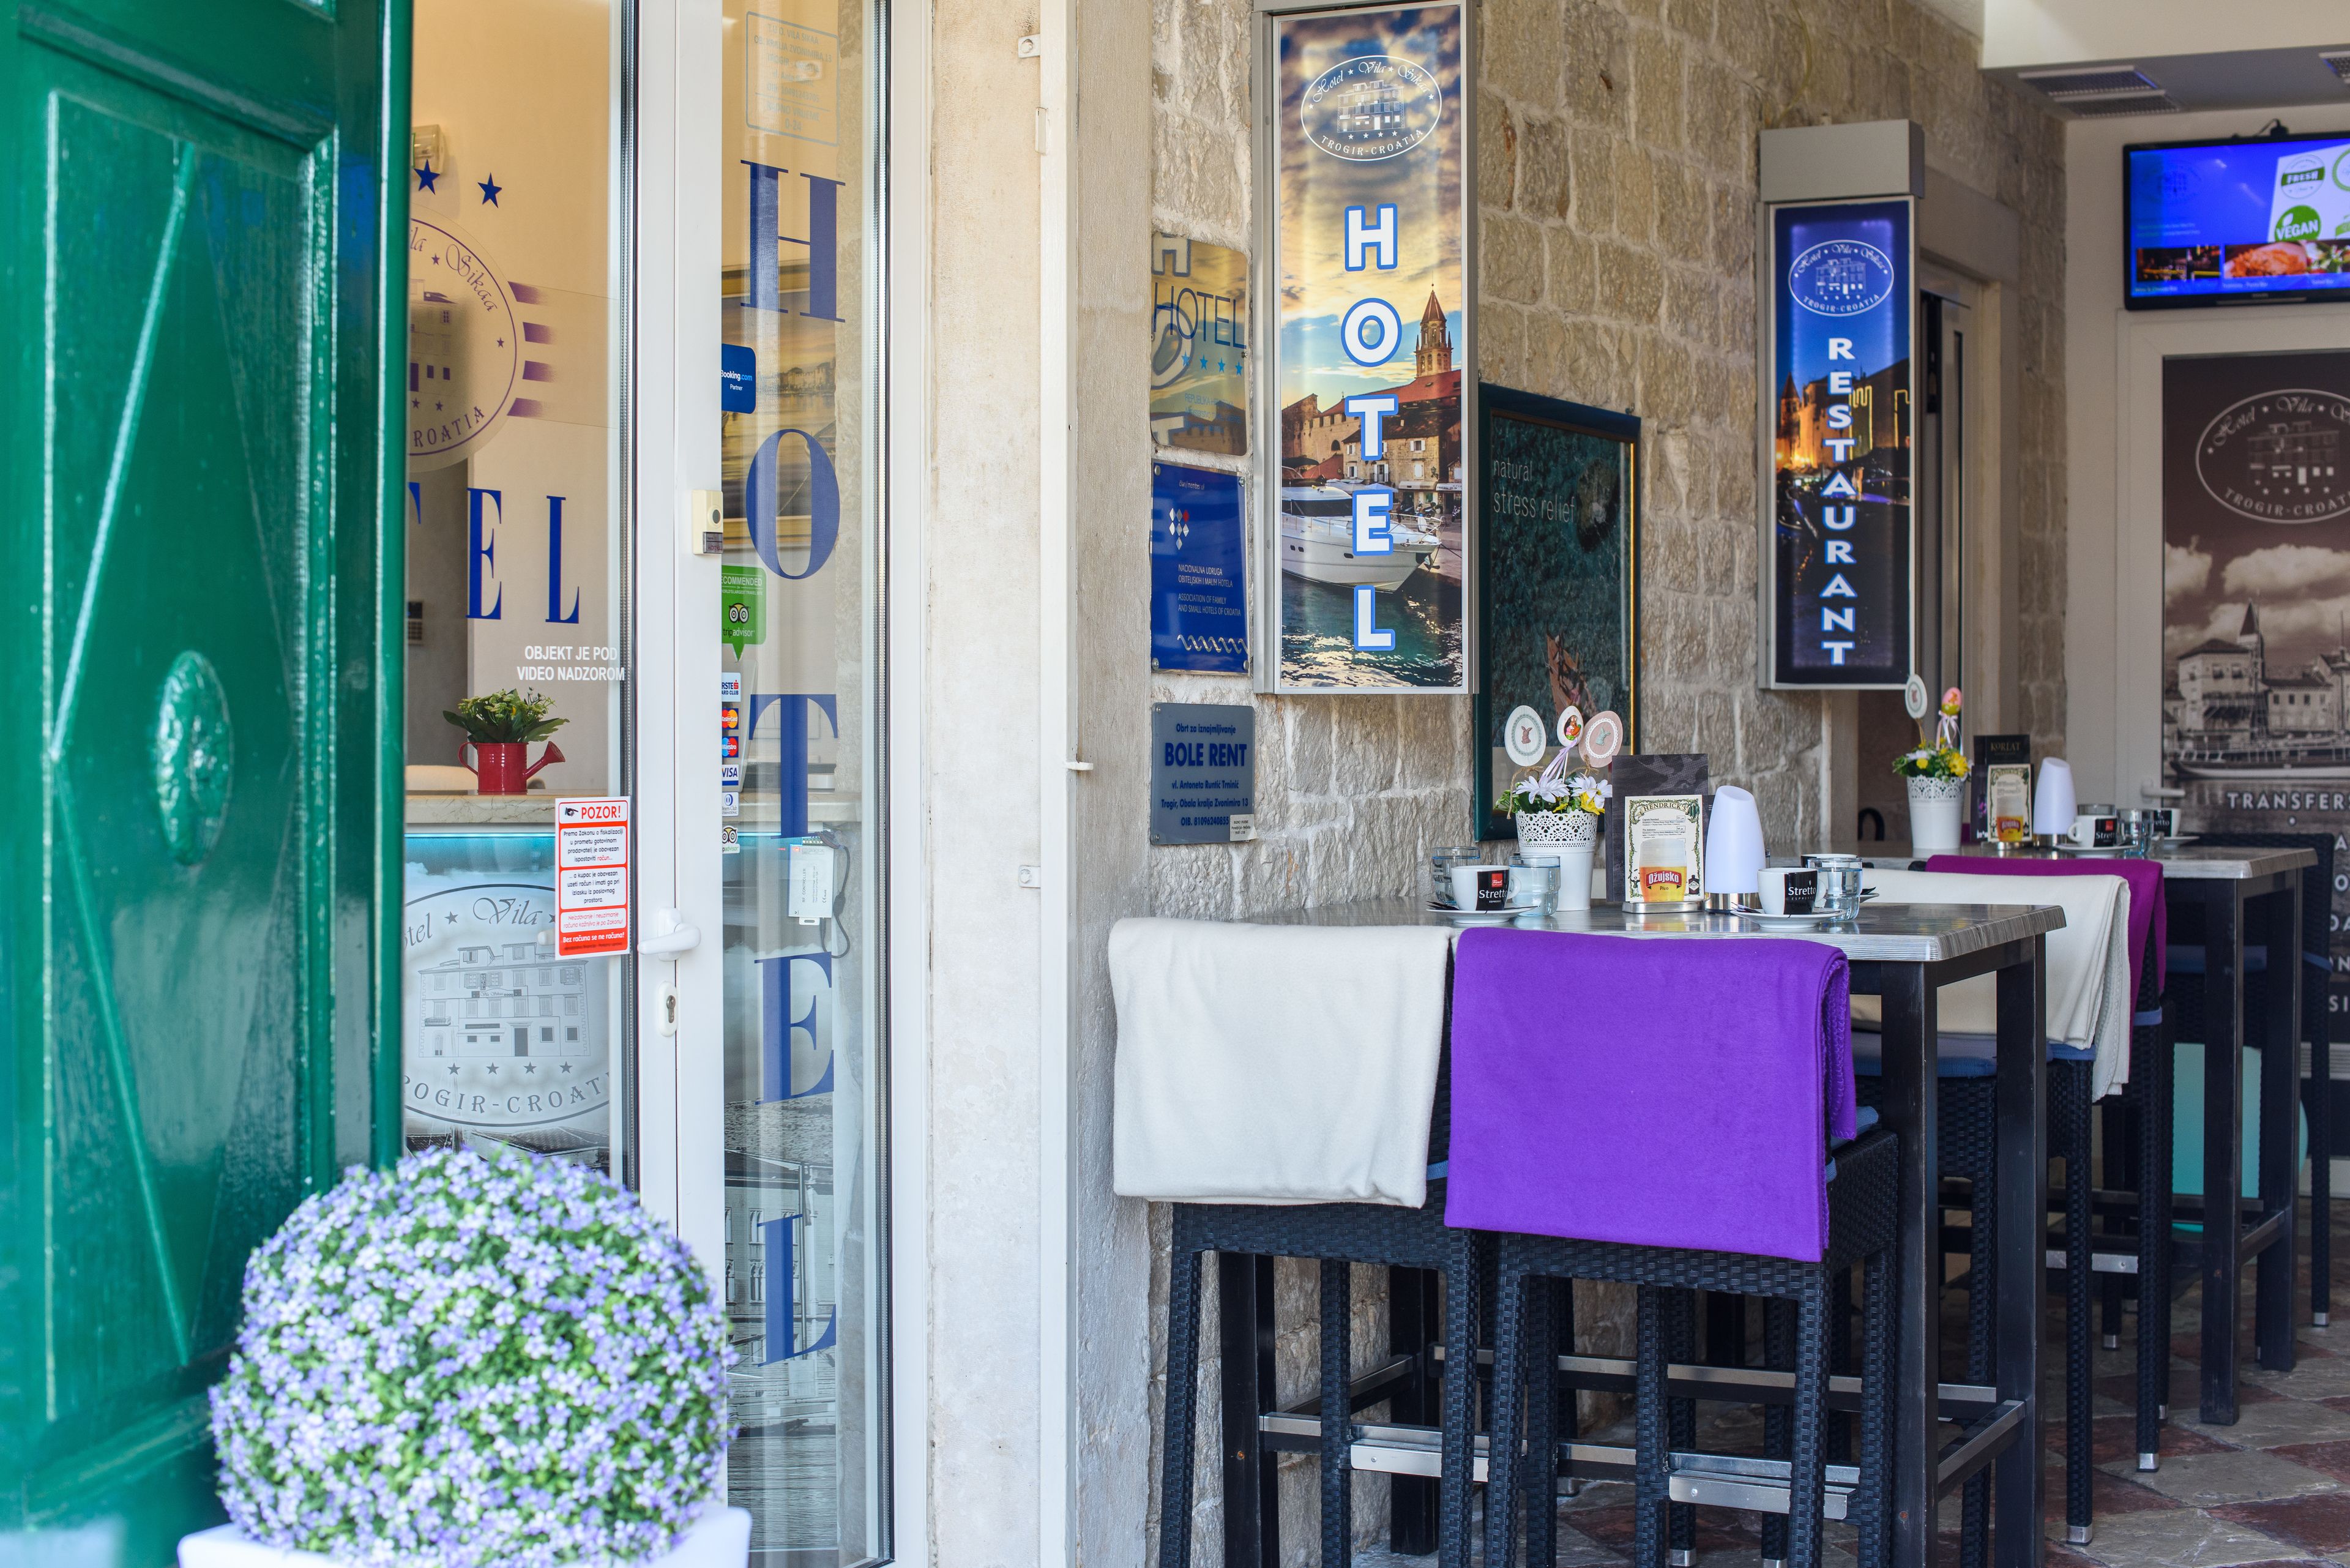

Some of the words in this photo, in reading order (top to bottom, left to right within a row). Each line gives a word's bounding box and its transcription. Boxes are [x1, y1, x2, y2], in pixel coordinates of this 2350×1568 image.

[1313, 70, 1343, 102] Hotel
[1359, 62, 1386, 73] Vila
[1398, 65, 1430, 93] Sikaa
[1321, 129, 1423, 155] TROGIR-CROATIA
[2287, 170, 2319, 184] FRESH
[2276, 219, 2319, 240] VEGAN
[1153, 282, 1247, 349] HOTEL
[1340, 203, 1402, 651] HOTEL
[1494, 457, 1532, 482] natural
[1493, 487, 1536, 518] stress
[1541, 495, 1575, 523] relief
[1819, 337, 1857, 665] RESTAURANT
[1179, 564, 1205, 574] NACIONALNA
[1206, 567, 1223, 575] UDRUGA
[1179, 575, 1202, 585] OBITELJSKIH
[1218, 579, 1233, 588] HOTELA
[1178, 593, 1205, 602] ASSOCIATION
[1224, 608, 1240, 616] CROATIA
[723, 627, 753, 638] tripadvisor
[524, 646, 573, 660] OBJEKT
[575, 646, 590, 660] JE
[594, 647, 617, 660] POD
[517, 666, 554, 681] VIDEO
[558, 666, 625, 681] NADZOROM
[1176, 723, 1188, 732] Obrt
[1198, 724, 1236, 735] iznajmljivanje
[1165, 742, 1204, 766] BOLE
[1209, 744, 1247, 766] RENT
[722, 767, 737, 777] VISA
[1180, 780, 1204, 789] Antoneta
[1162, 799, 1178, 810] Trogir,
[1180, 799, 1196, 807] Obala
[1198, 798, 1213, 809] kralja
[1215, 798, 1240, 807] Zvonimira
[1643, 802, 1687, 812] HENDRICK'S
[2226, 792, 2350, 810] TRANSFER
[581, 805, 621, 819] POZOR!
[1181, 817, 1192, 826] OIB.
[1194, 816, 1229, 826] 81096240855
[1649, 872, 1679, 884] Ožujsko
[1788, 887, 1816, 895] Stretto
[473, 897, 542, 925] Vila
